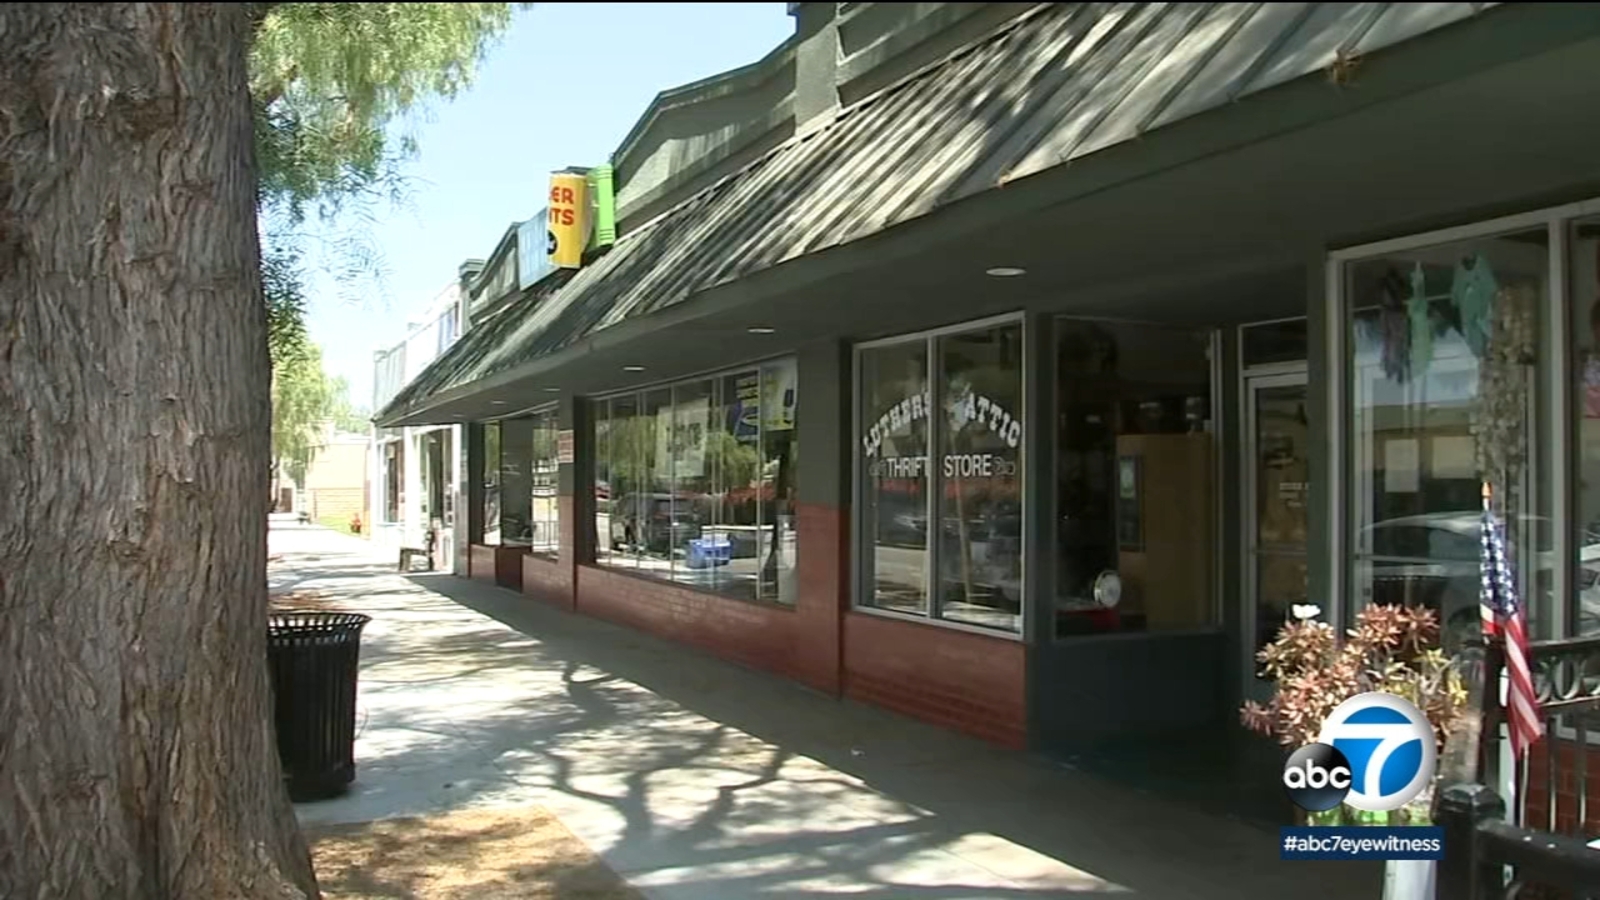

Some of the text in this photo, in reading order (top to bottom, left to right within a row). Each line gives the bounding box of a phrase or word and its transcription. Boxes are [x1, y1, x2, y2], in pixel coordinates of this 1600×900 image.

[965, 392, 1021, 448] ATTIC
[887, 454, 992, 478] THRIFT STORE
